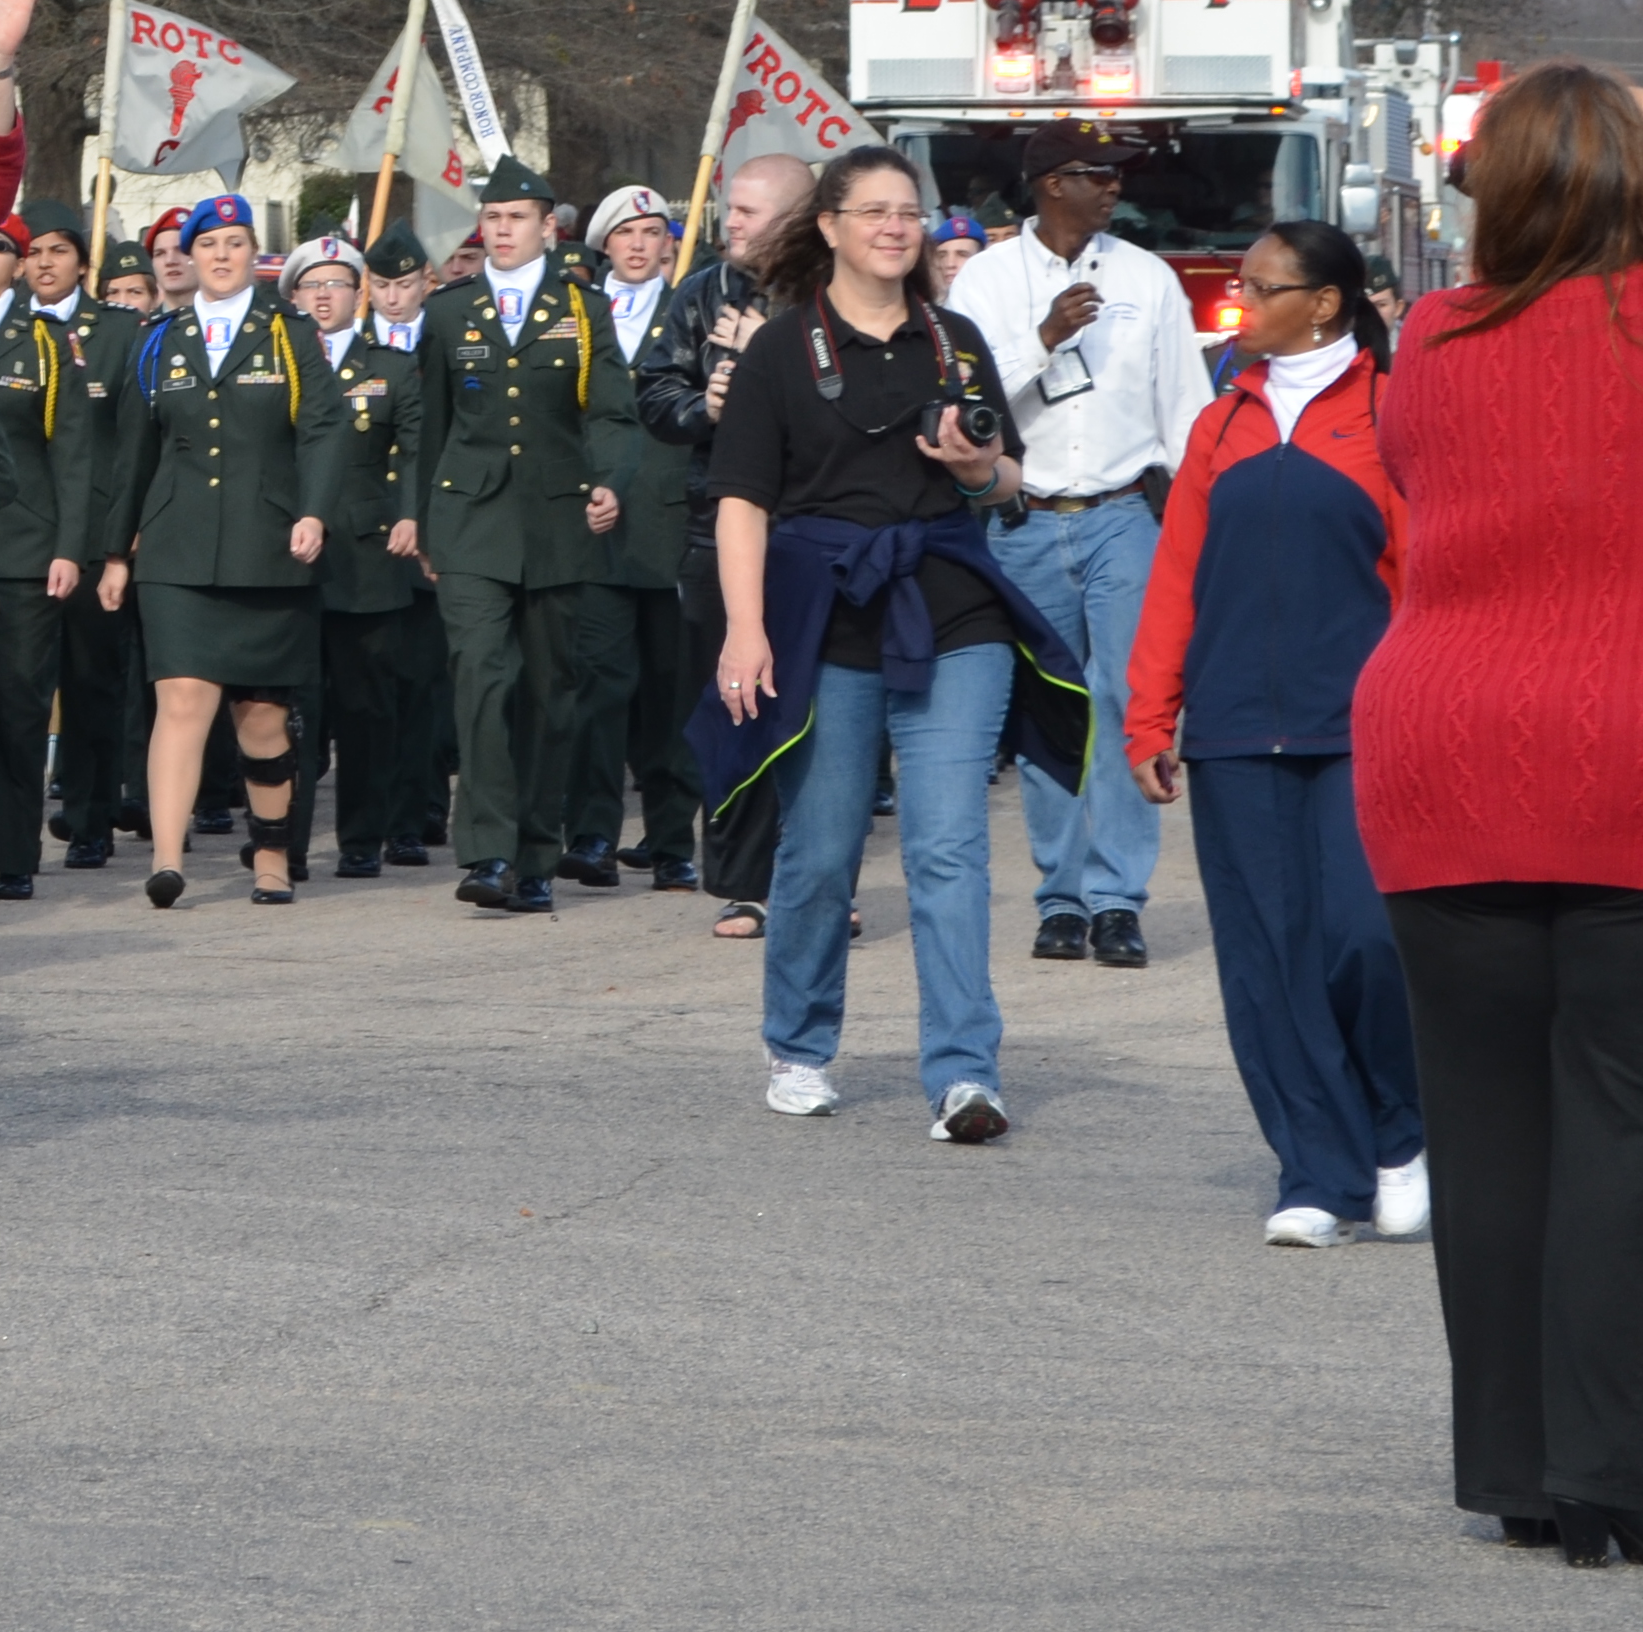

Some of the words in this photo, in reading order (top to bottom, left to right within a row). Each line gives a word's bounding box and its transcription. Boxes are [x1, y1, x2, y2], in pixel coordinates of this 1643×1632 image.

[130, 10, 243, 66] ROTC
[448, 25, 480, 91] COMPANY
[469, 91, 496, 139] HONOR
[441, 148, 464, 188] B
[811, 327, 832, 369] Canon
